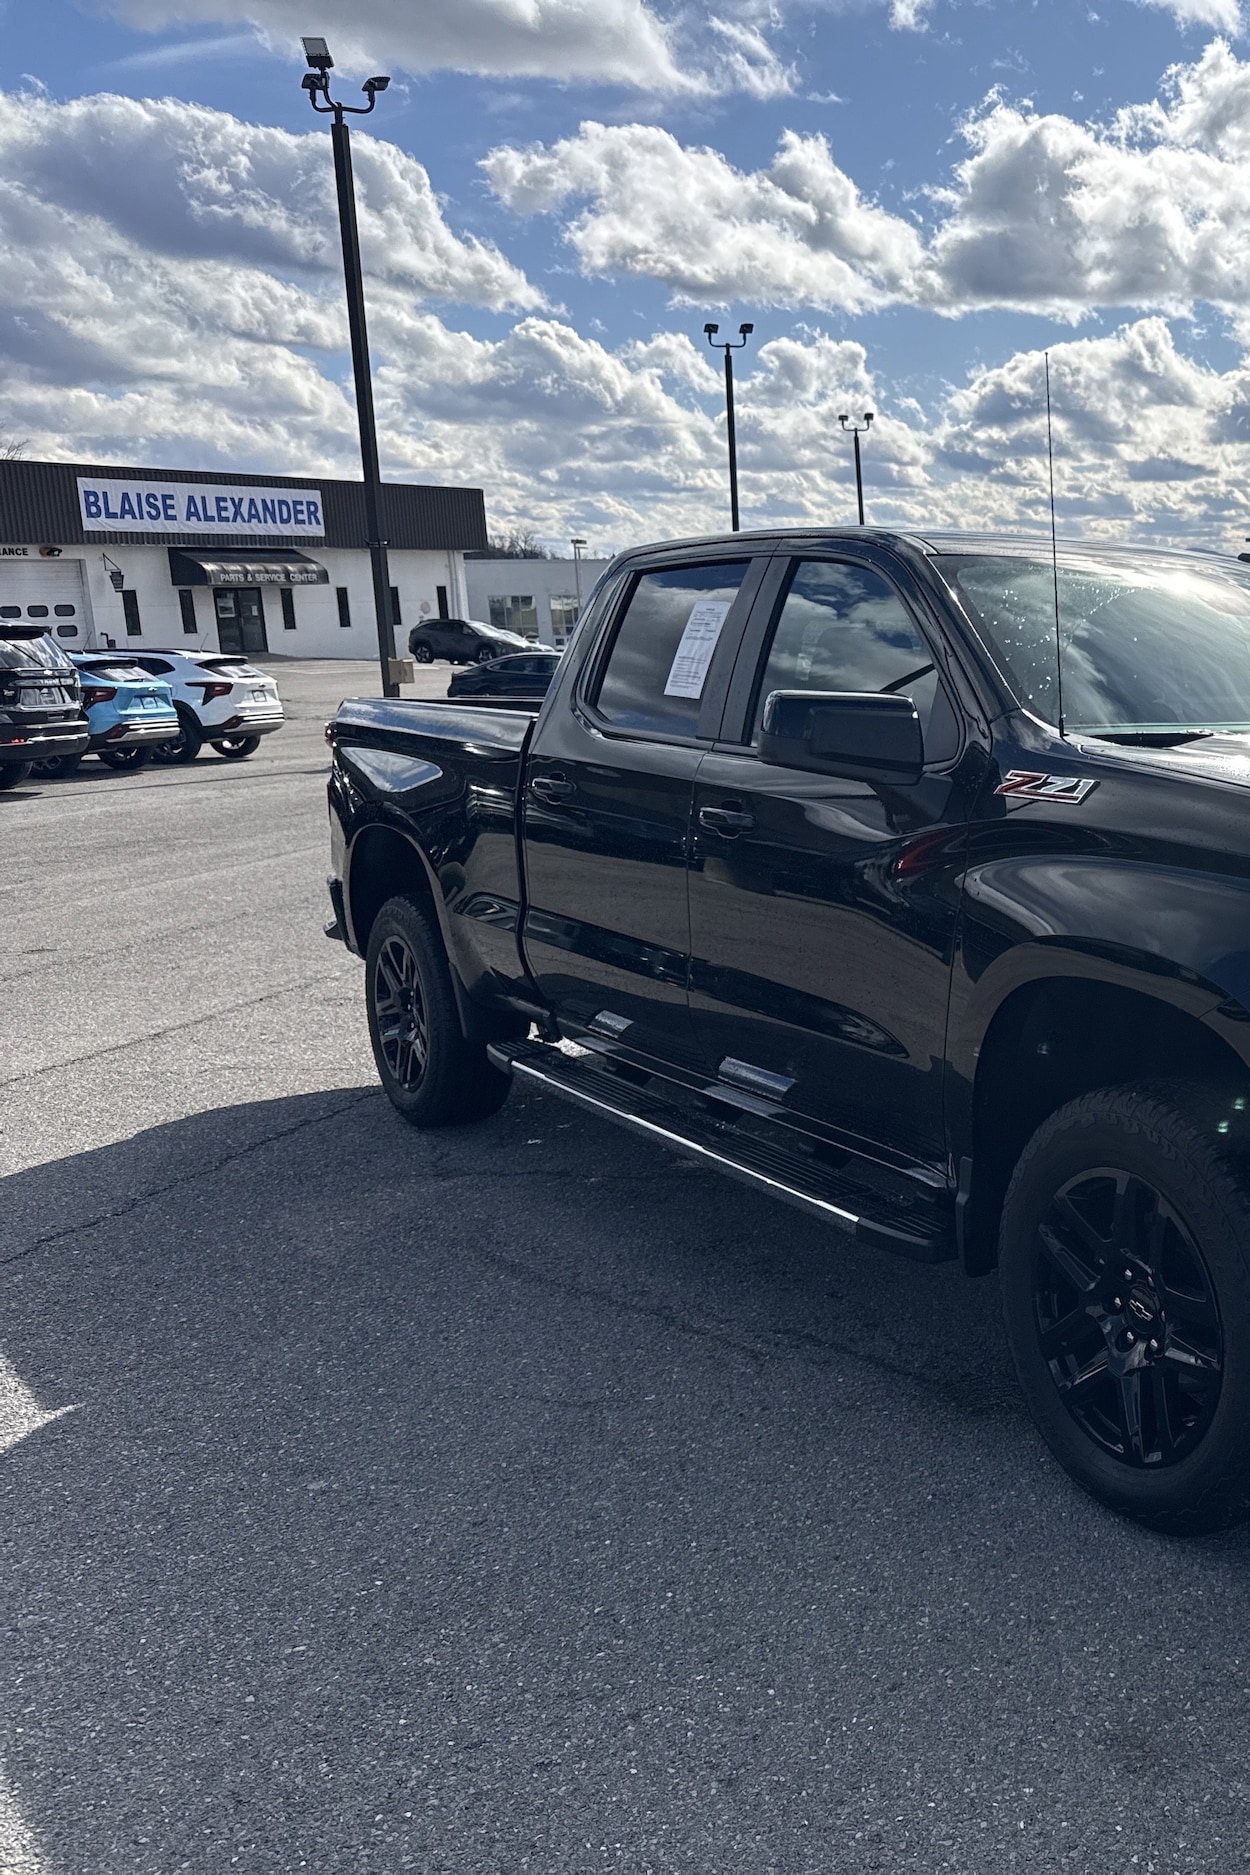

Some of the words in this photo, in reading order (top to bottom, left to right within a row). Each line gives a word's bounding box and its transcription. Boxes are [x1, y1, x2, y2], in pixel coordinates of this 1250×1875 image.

[83, 490, 178, 521] BLAISE
[185, 495, 322, 525] ALEXANDER
[220, 573, 245, 581] PARTS
[247, 573, 253, 581] &
[255, 573, 286, 581] SERVICE
[290, 573, 318, 581] CENTER
[993, 769, 1100, 805] Z71
